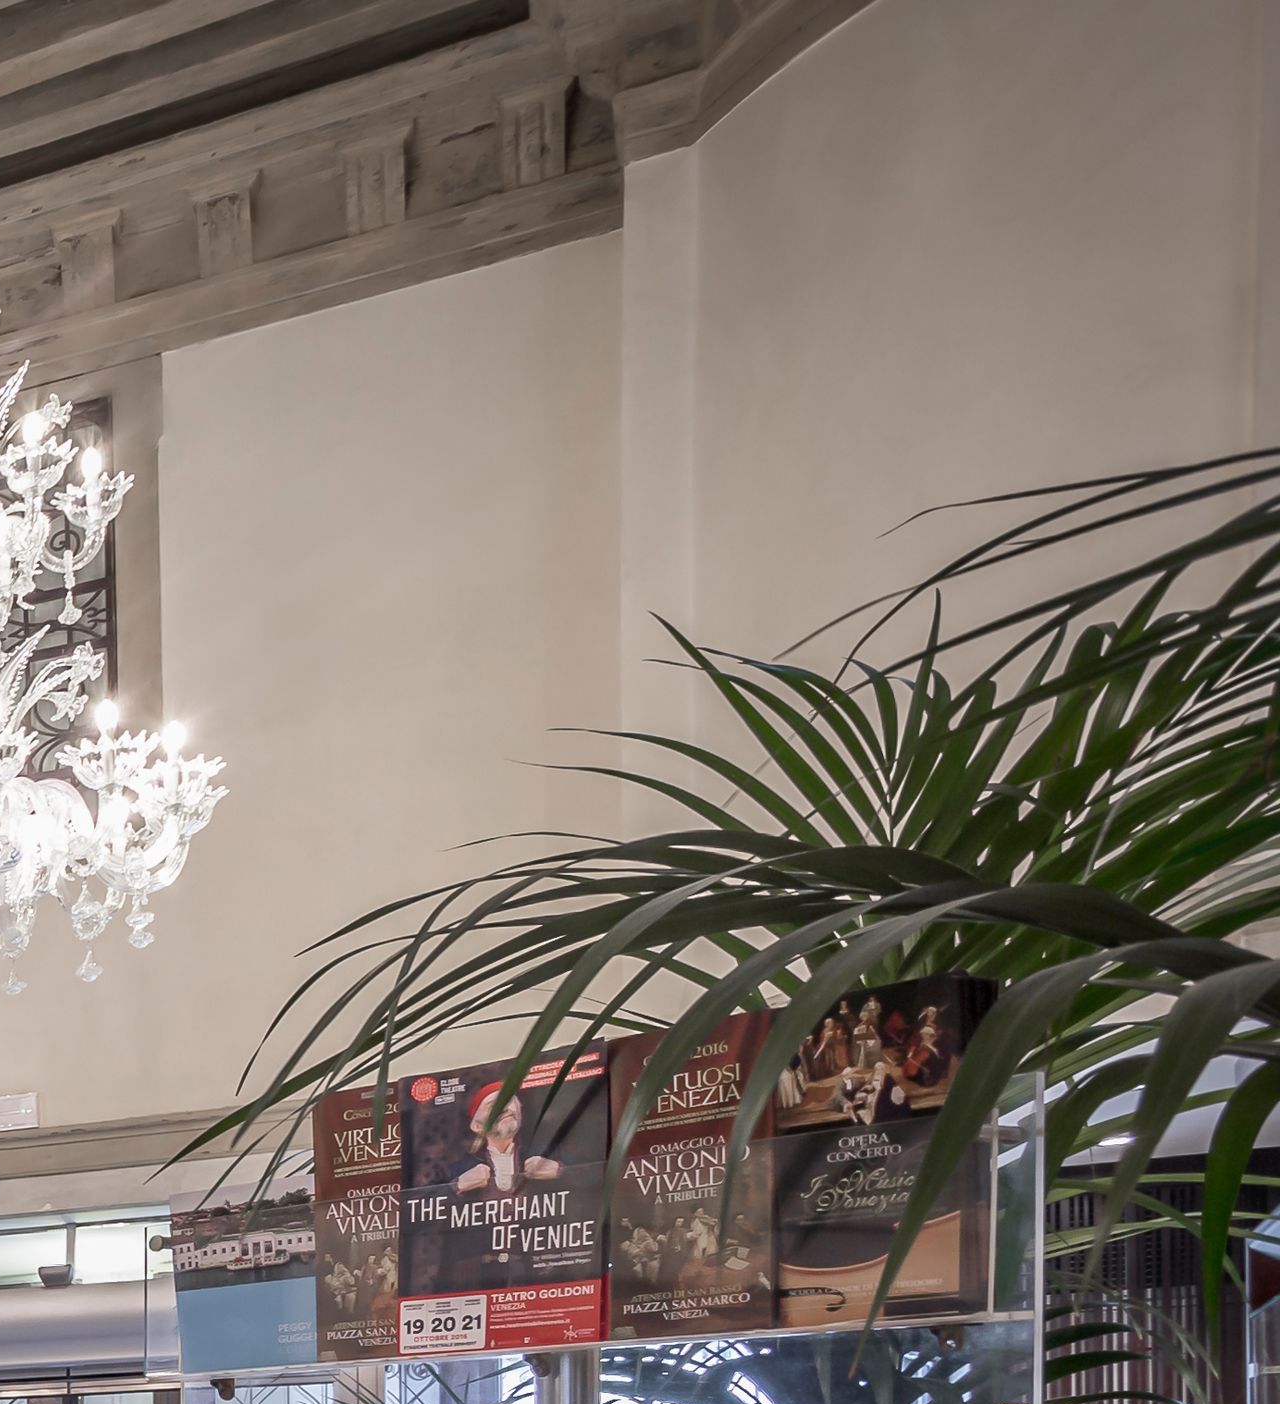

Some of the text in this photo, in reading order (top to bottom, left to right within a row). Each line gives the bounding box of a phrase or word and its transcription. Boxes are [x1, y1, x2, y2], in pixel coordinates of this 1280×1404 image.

[691, 1041, 729, 1059] 2016
[657, 1084, 741, 1114] ENEZIA
[650, 1134, 726, 1155] OMAGGIO A
[838, 1132, 889, 1149] OPERA
[826, 1144, 902, 1163] CONCERTO
[347, 1183, 400, 1199] OMAGGIO
[654, 1186, 718, 1205] A TRIBUTE
[407, 1190, 570, 1229] THE MERCHANT
[351, 1234, 358, 1243] A
[492, 1220, 594, 1252] OF VENICE
[491, 1284, 595, 1304] TEATRO GOLDONI
[491, 1302, 526, 1313] VENEZIA
[623, 1292, 751, 1315] PIAZZA SAN MARCO
[403, 1318, 425, 1335] 19
[431, 1315, 456, 1334] 20
[461, 1313, 483, 1331] 21
[662, 1309, 710, 1321] VENEZIA
[278, 1322, 312, 1333] PEGGY
[327, 1326, 388, 1341] PIAZZA SAN
[358, 1336, 398, 1347] VENEZIA
[413, 1334, 449, 1343] OTTOBRE
